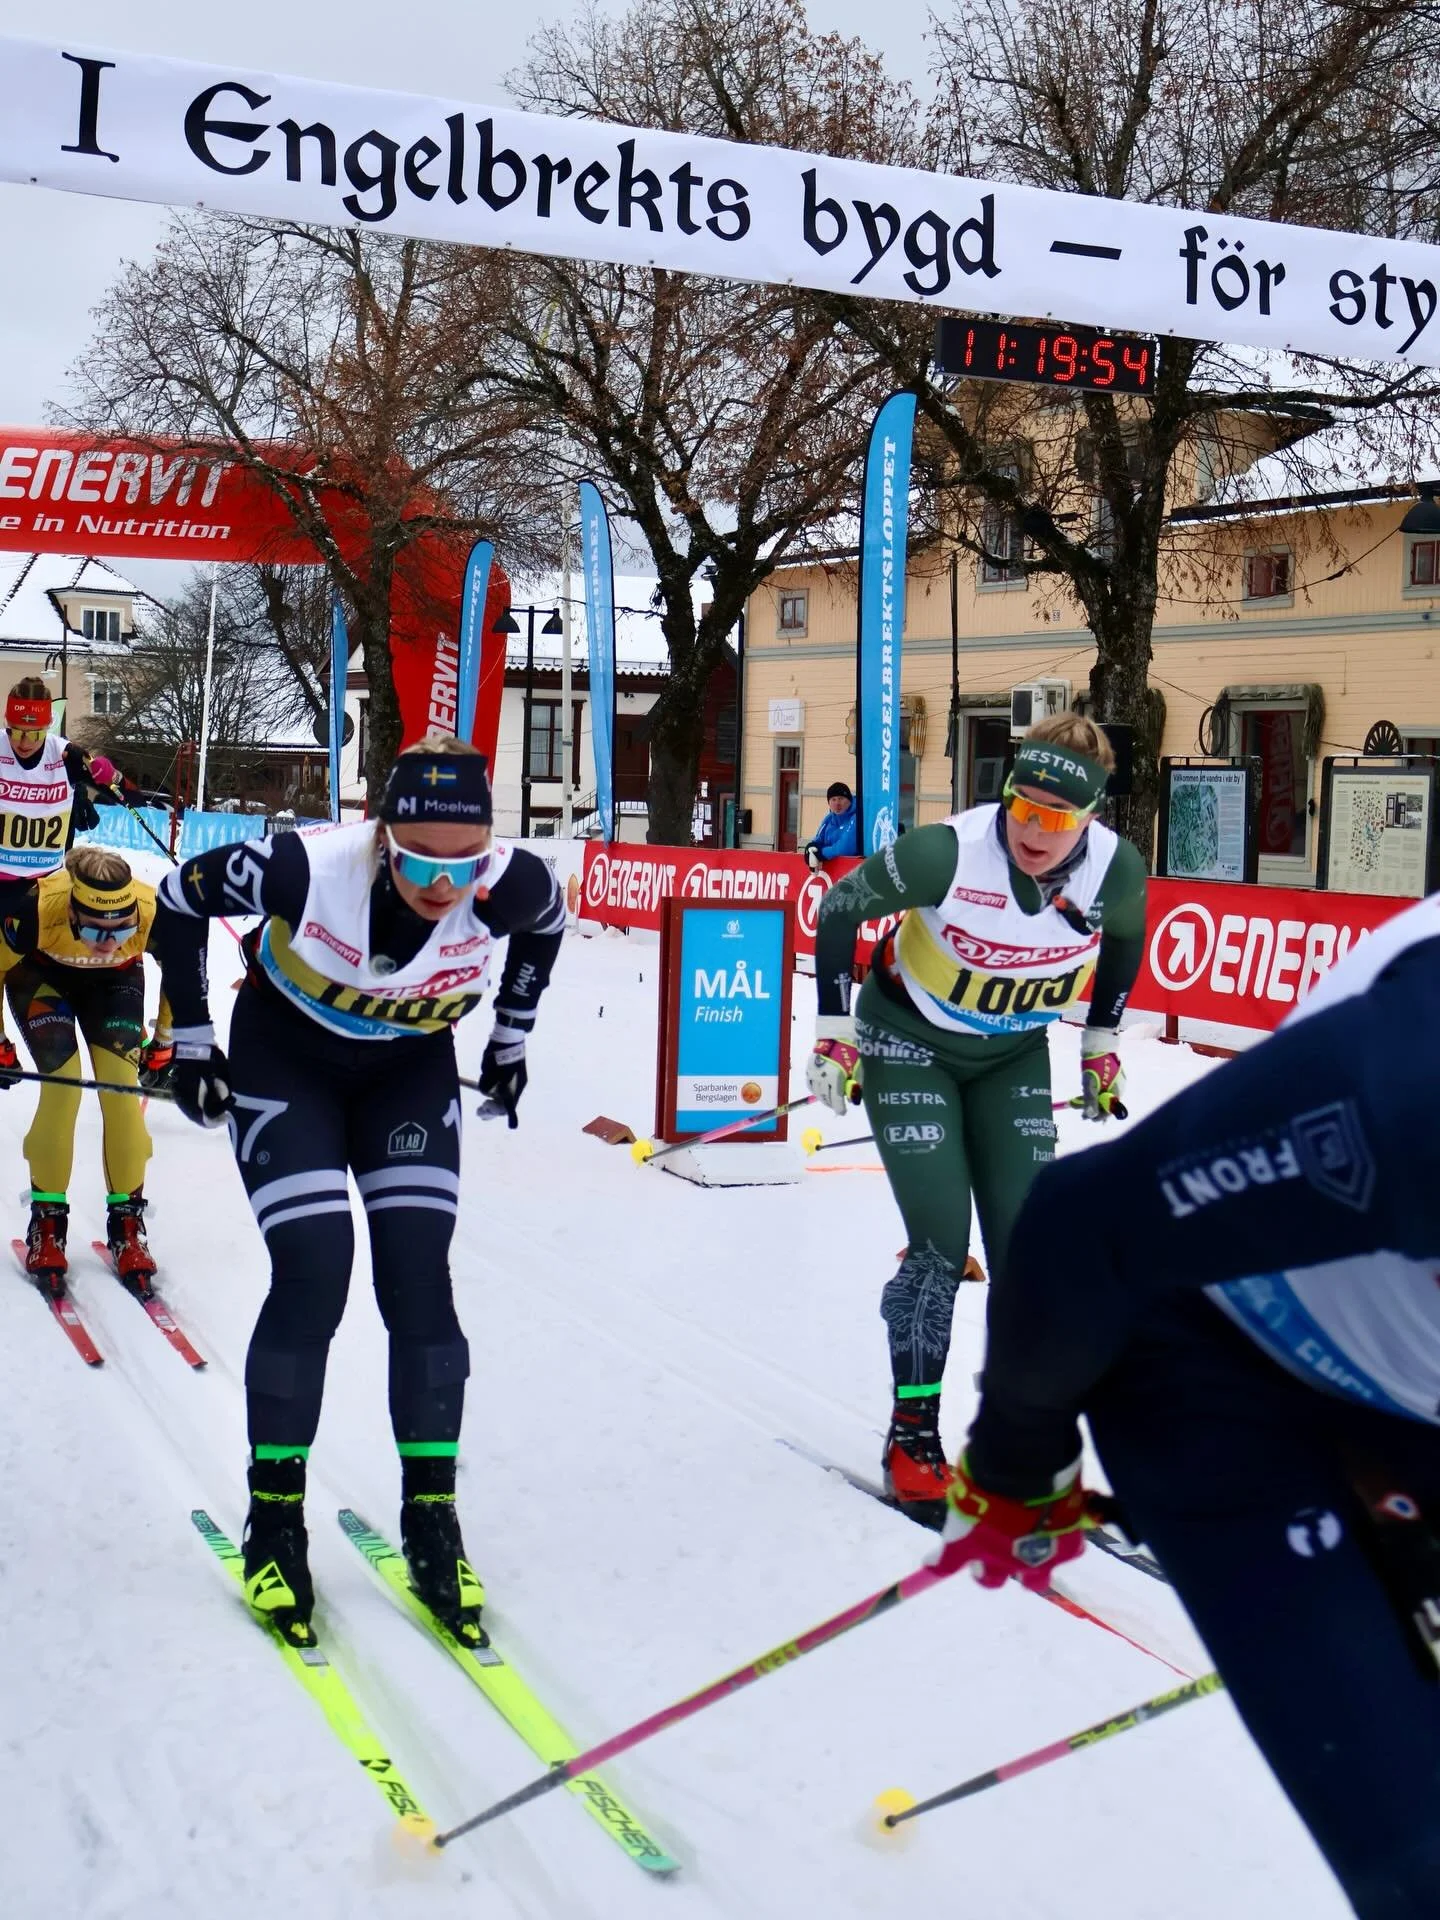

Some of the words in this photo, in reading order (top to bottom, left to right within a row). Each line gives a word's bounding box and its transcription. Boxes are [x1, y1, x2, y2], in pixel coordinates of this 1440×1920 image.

[61, 52, 120, 163] I
[184, 81, 750, 242] Engelbrekts
[801, 168, 1002, 296] bygd
[1179, 225, 1286, 316] för
[1329, 262, 1438, 354] sty
[964, 328, 1149, 387] 11:19:54
[0, 447, 234, 508] ENERVIT
[32, 513, 65, 532] in
[76, 515, 231, 540] Nutrition
[881, 436, 897, 793] ENGELBREKTSLOPPET
[1019, 749, 1088, 782] HESTRA
[9, 785, 66, 801] ENERVIT
[424, 799, 482, 814] Moelven
[694, 960, 770, 999] MÅL
[694, 1005, 743, 1023] Finish
[693, 1083, 738, 1094] Sparbanken
[695, 1092, 738, 1103] Bergslagen
[878, 1092, 947, 1106] HESTRA
[395, 1132, 421, 1150] YLAB
[888, 1125, 940, 1143] EAB
[1161, 1138, 1301, 1218] FRONT
[576, 1779, 662, 1858] FISCHER
